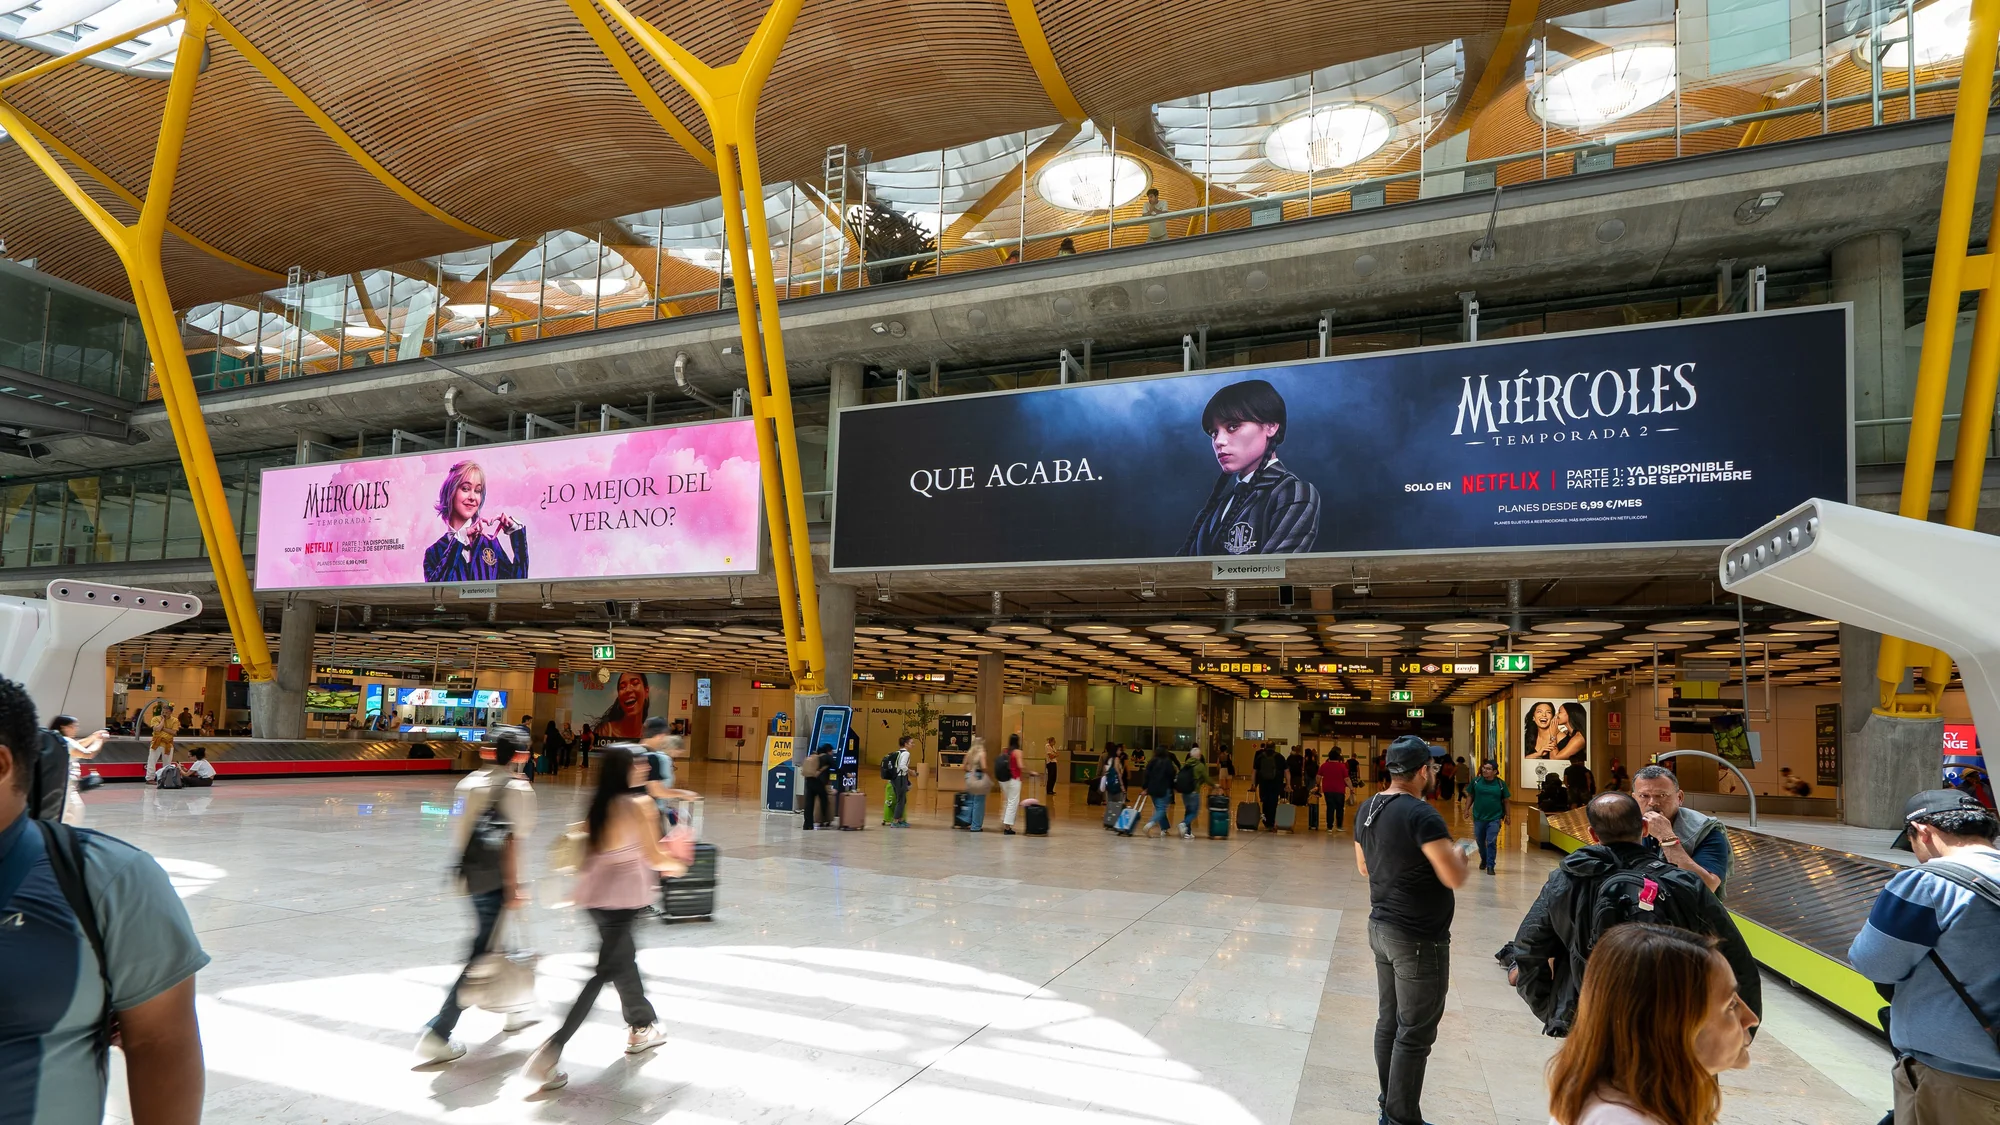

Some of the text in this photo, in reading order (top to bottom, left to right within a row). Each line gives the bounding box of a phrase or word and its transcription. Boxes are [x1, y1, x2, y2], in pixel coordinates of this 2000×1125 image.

[1450, 362, 1698, 436] MIÉRCOLES
[1492, 426, 1649, 447] TEMPORADA 2
[910, 457, 1103, 498] QUE ACABA.
[1567, 461, 1734, 480] PARTE 1: YA DISPONIBLE
[1567, 470, 1752, 490] PARTE 2: 3 DE SEPTIEMBRE
[540, 472, 713, 510] ¿LO MEJOR DEL
[1404, 471, 1541, 495] SOLO EN NETFLIX
[303, 480, 390, 519] MIÉRCOLES
[1498, 498, 1643, 514] PLANES DESDE 6,99 €/MES
[317, 518, 366, 527] TEMPORADA
[569, 507, 677, 532] VERANO?
[305, 541, 334, 555] NETFLIX
[370, 538, 399, 546] DISPONIBLE
[373, 543, 405, 551] SEPTIEMBRE
[1227, 564, 1281, 574] exteriorplus
[773, 749, 791, 758] Cajero
[774, 741, 791, 749] ATM
